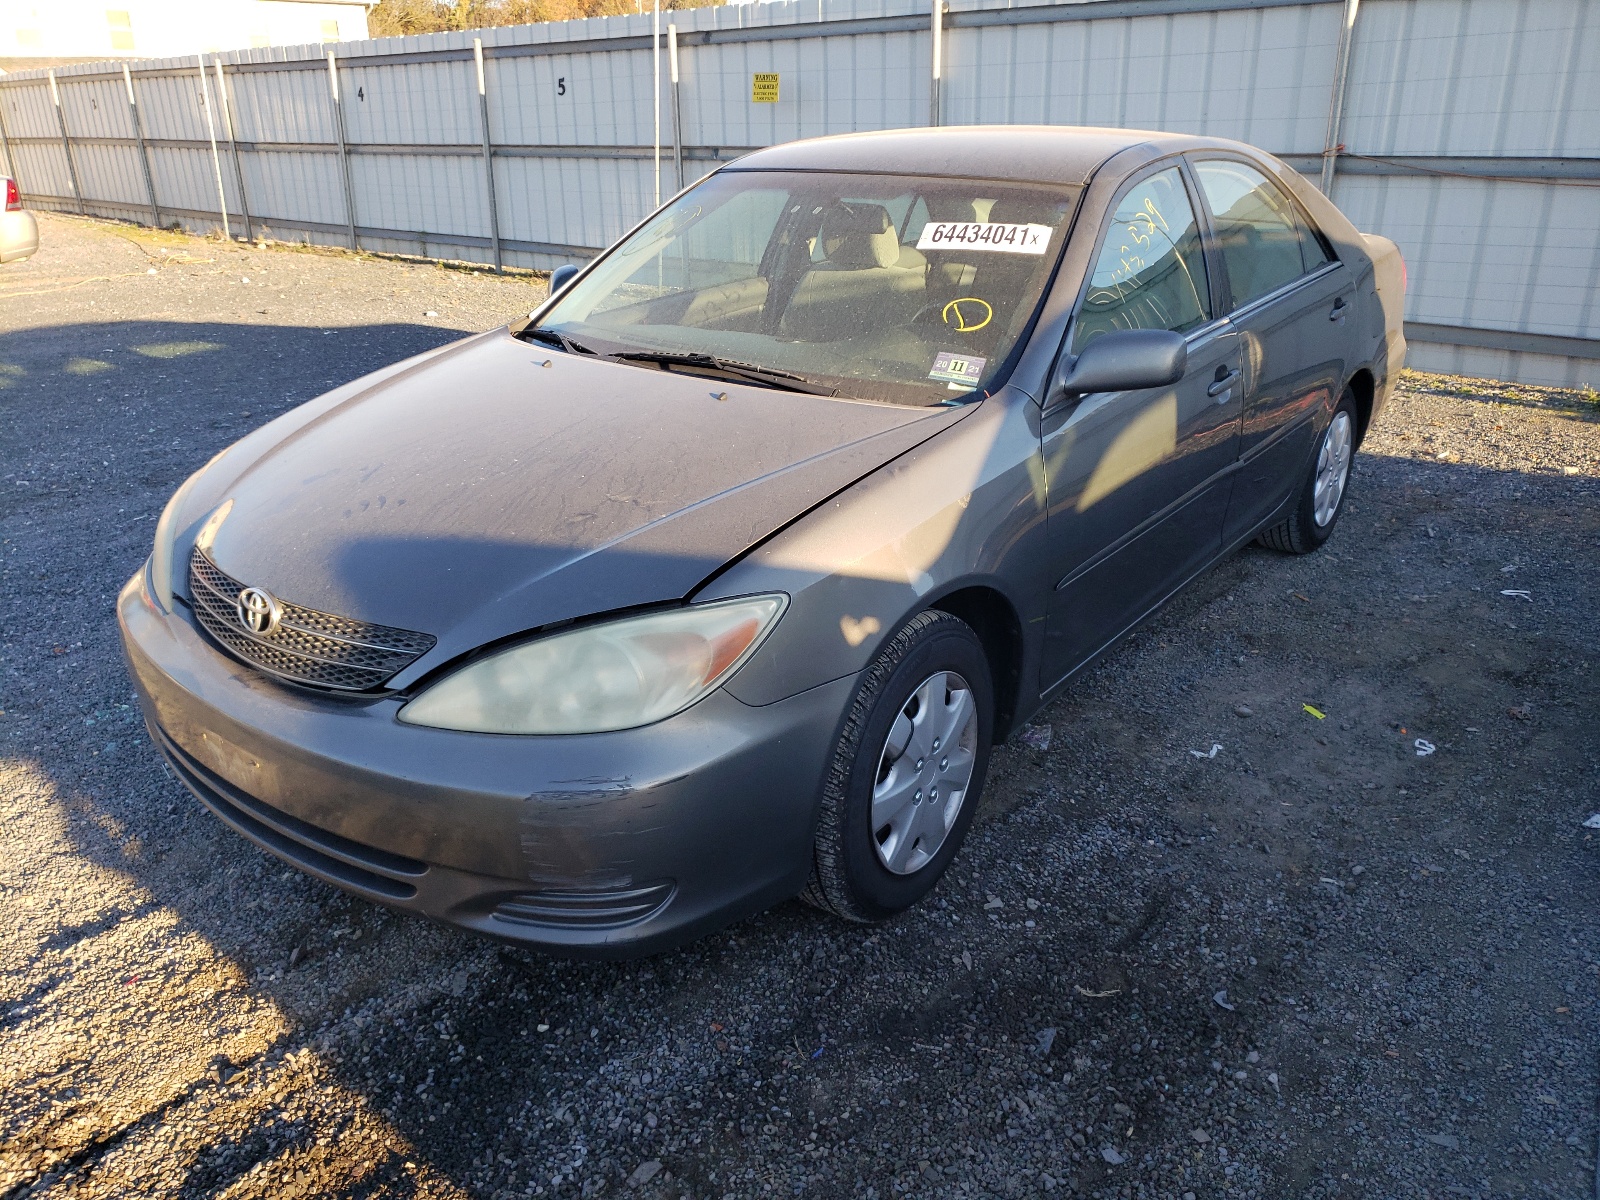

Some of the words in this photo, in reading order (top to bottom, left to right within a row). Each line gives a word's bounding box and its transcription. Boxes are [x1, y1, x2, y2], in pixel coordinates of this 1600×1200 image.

[357, 86, 364, 102] 4
[557, 76, 566, 96] 5
[936, 360, 949, 369] 20
[950, 360, 966, 373] 11
